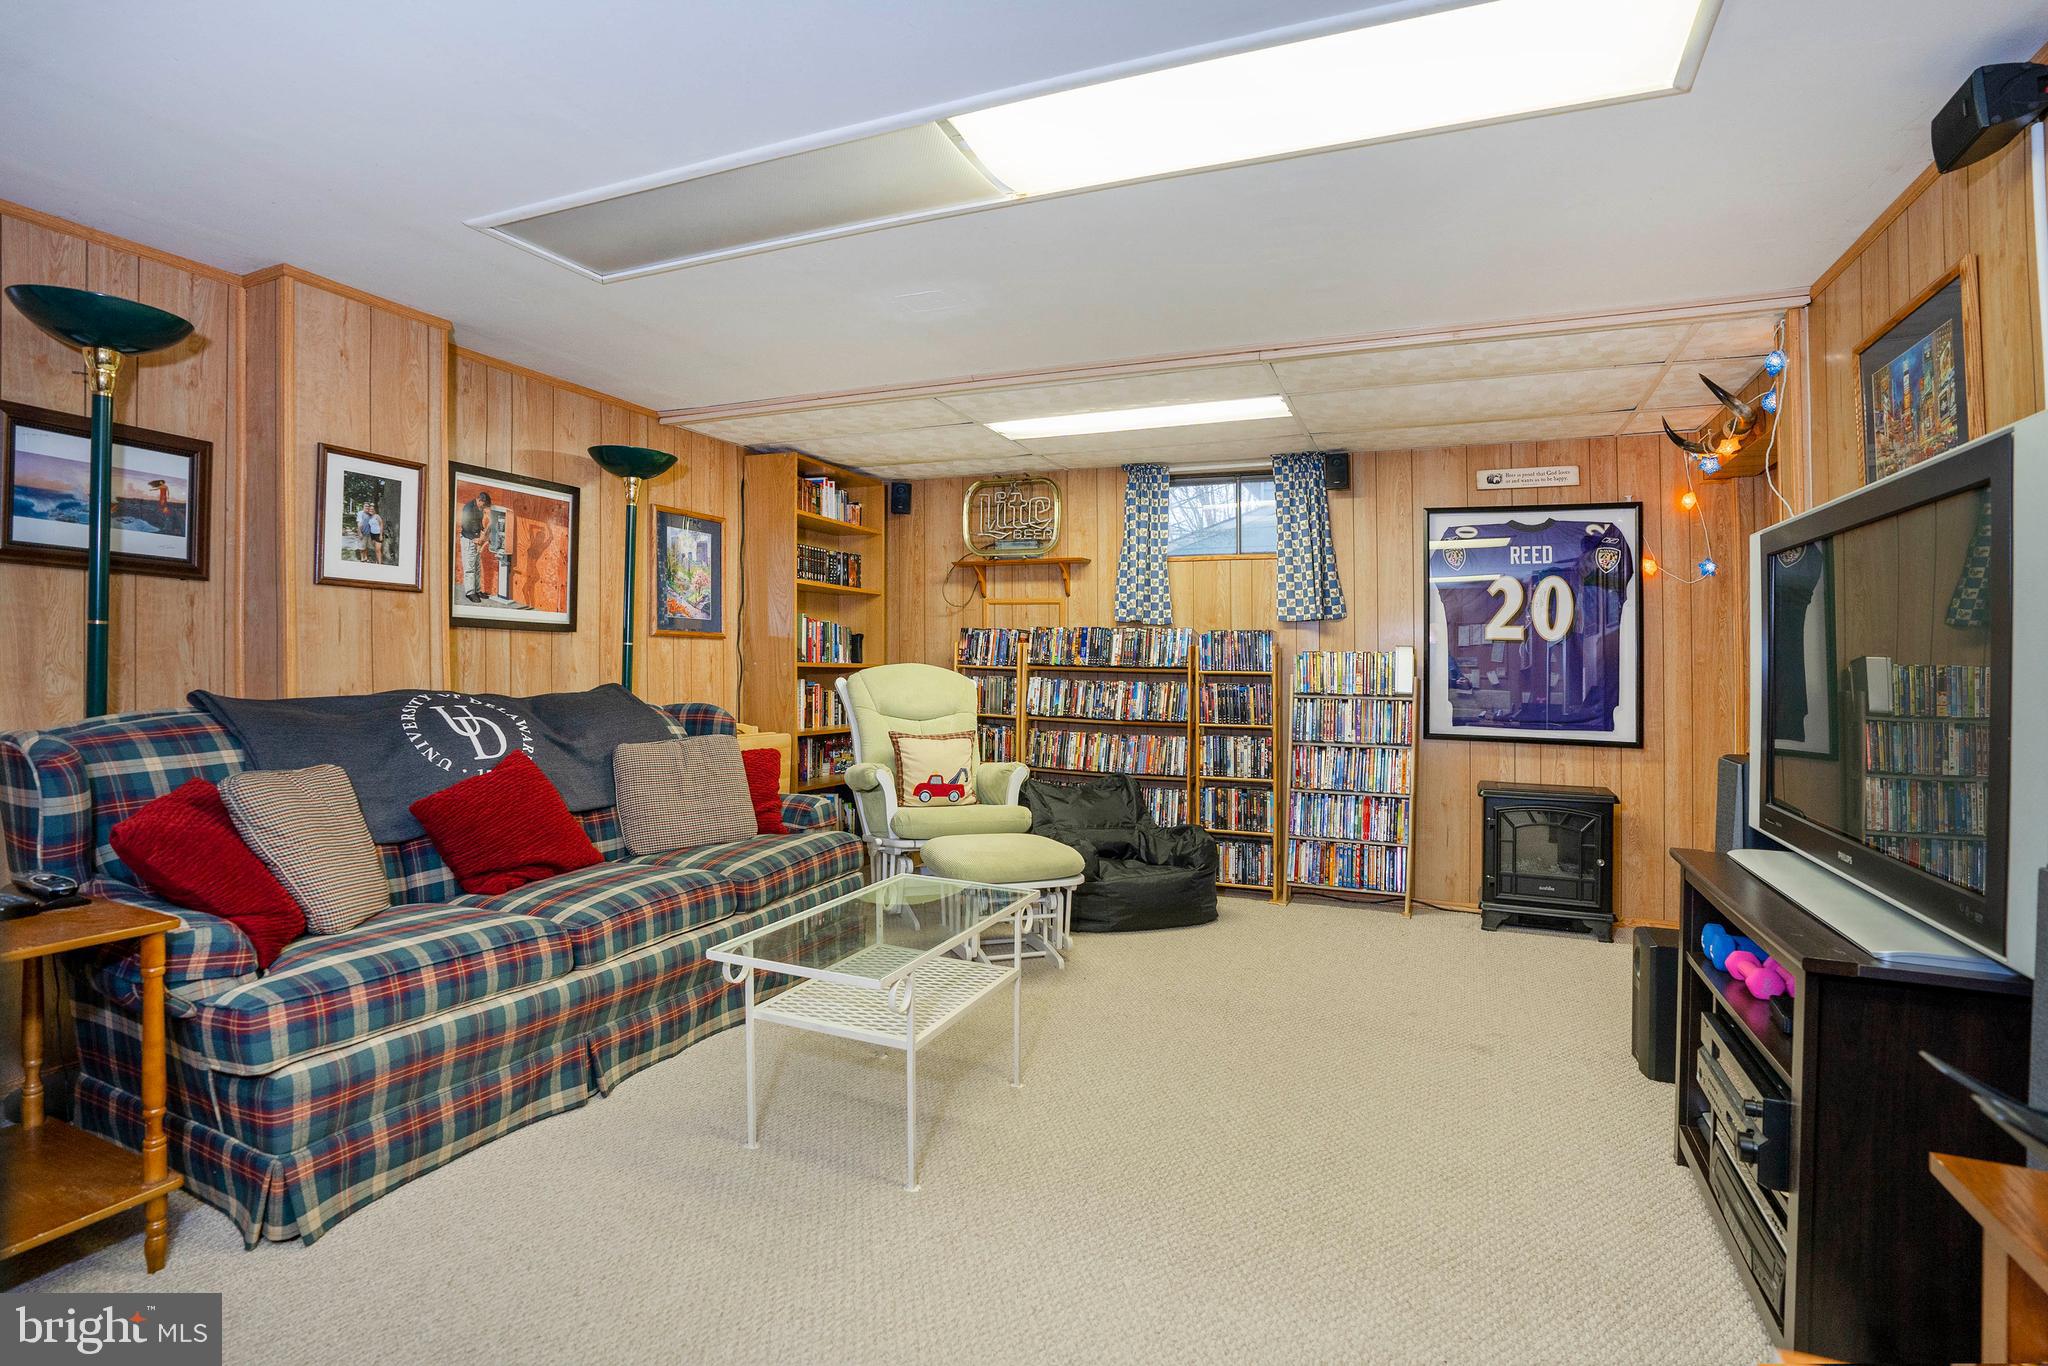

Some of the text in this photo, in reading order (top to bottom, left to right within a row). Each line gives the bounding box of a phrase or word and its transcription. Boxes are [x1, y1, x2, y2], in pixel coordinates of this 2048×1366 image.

[977, 491, 1054, 540] Lite
[1012, 529, 1053, 540] BEER
[1510, 545, 1553, 565] REED
[1485, 574, 1575, 642] 20
[400, 693, 453, 772] UNIVERSITY
[469, 696, 535, 761] DELAWAR
